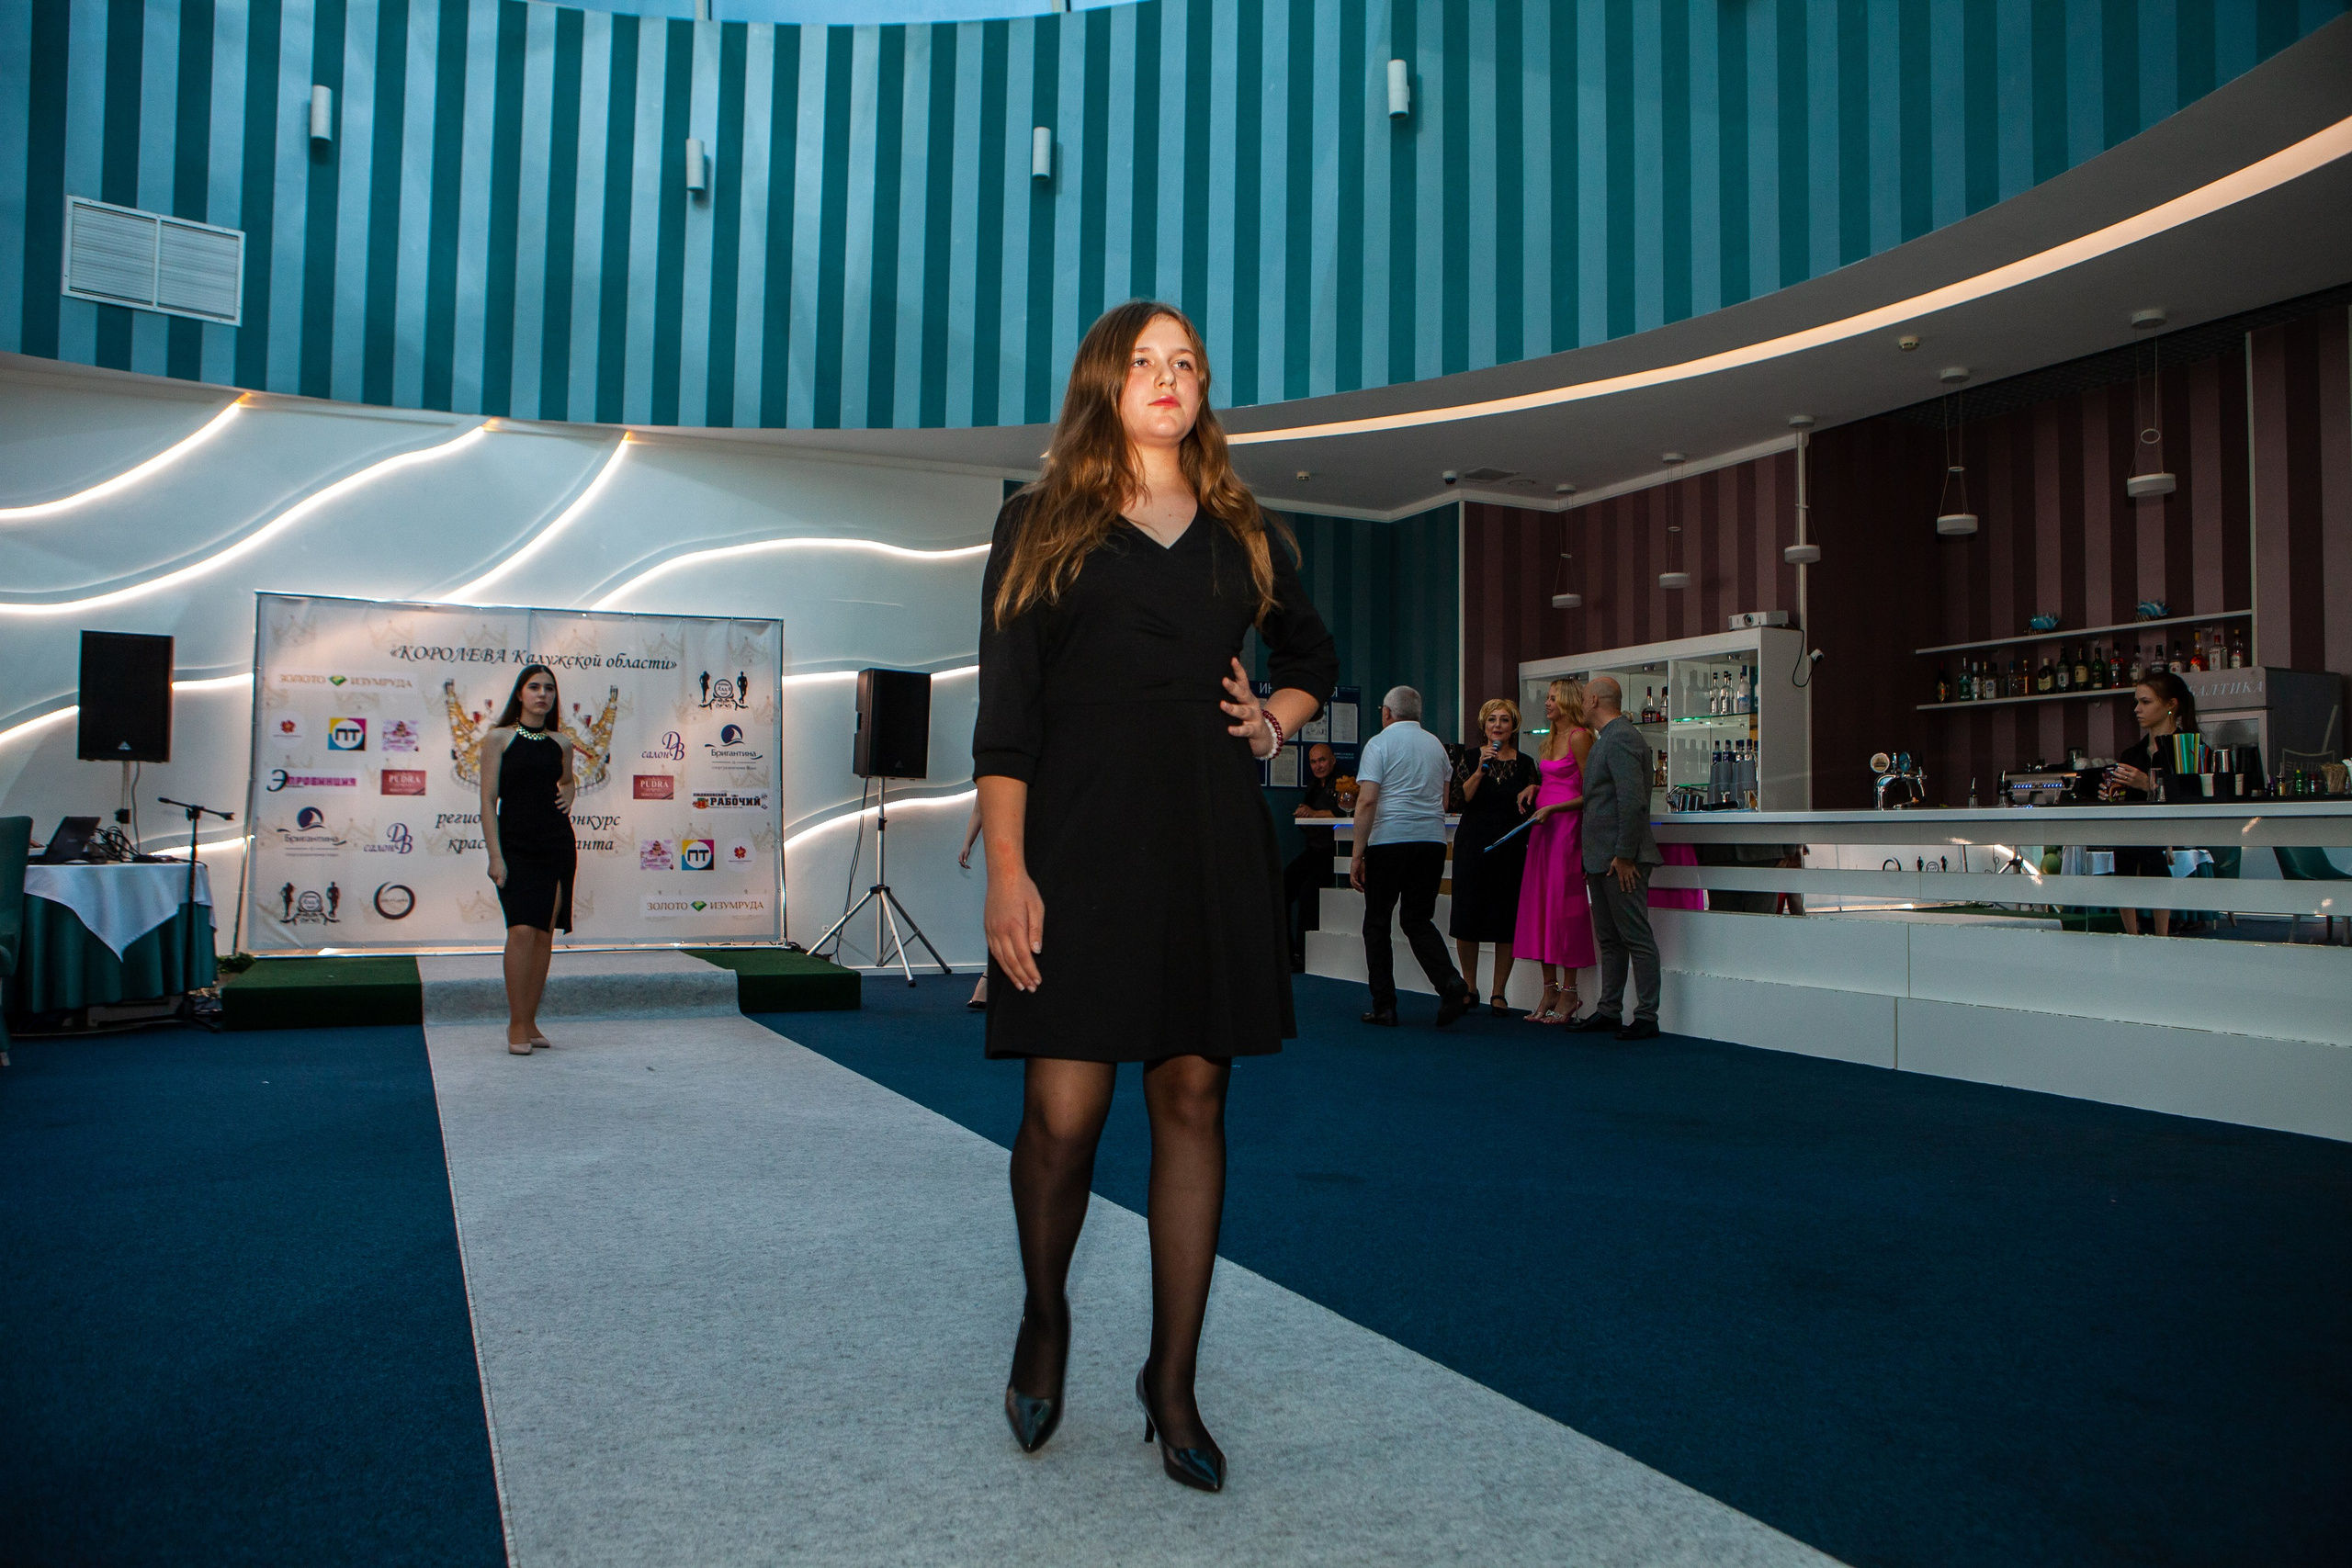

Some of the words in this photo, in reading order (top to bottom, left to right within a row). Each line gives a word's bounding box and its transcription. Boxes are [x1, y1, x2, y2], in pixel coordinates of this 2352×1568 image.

[390, 645, 506, 663] «КОРОЛЕВА
[512, 649, 602, 670] Калужской
[605, 652, 677, 670] области»
[278, 674, 326, 684] ЗОЛОТО
[334, 728, 361, 741] ПТ
[641, 750, 669, 759] салон
[711, 749, 757, 758] Бригантина
[388, 774, 421, 784] PUDRA
[640, 780, 669, 788] PUDRA
[710, 795, 761, 807] РАБОЧИЙ
[570, 815, 621, 830] онкурс
[687, 849, 709, 862] ПТ
[647, 901, 688, 911] ЗОЛОТО
[710, 901, 764, 910] ИЗУМРУДА
